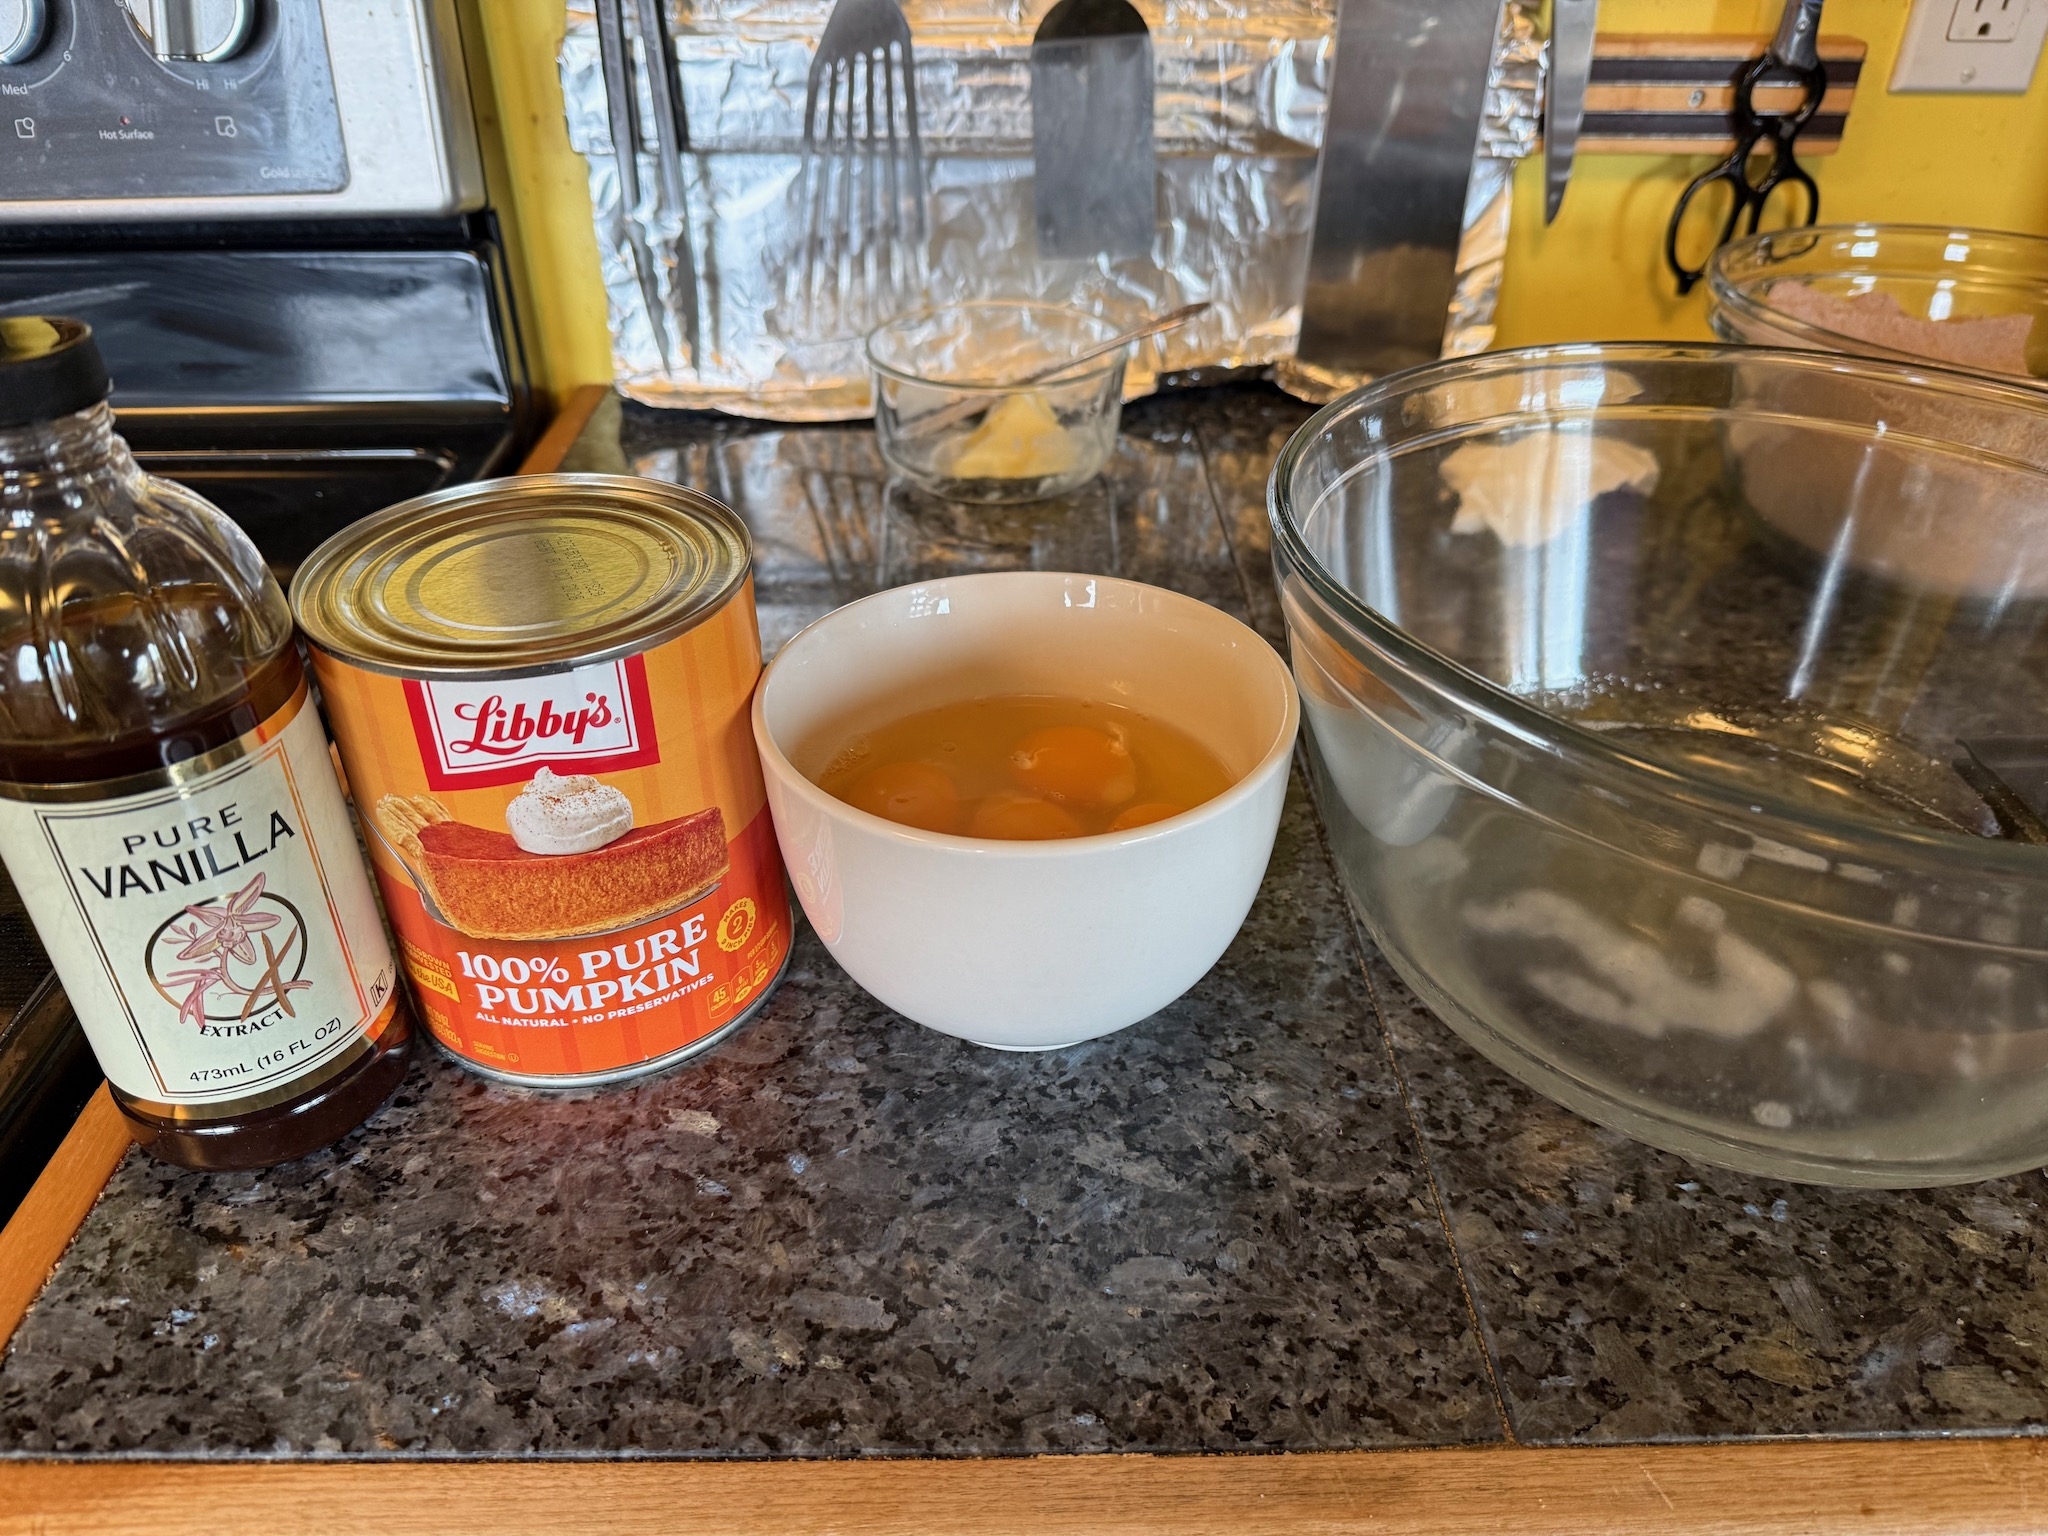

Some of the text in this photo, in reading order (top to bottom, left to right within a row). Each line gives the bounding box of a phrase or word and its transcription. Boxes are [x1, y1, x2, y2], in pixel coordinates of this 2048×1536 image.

[63, 51, 71, 62] 6
[2, 83, 28, 95] Med
[195, 79, 209, 91] Hi
[223, 79, 238, 91] Hi
[99, 129, 154, 140] Hot Surface
[450, 692, 612, 755] Libby's
[122, 802, 242, 855] PURE
[80, 810, 295, 898] VANILLA
[723, 900, 748, 923] MAKES
[732, 915, 743, 935] 2
[456, 913, 708, 984] 100% PURE
[431, 974, 454, 995] USA
[475, 948, 701, 1015] PUMPKIN
[475, 972, 715, 1028] ALL NATURAL NO PRESERVATIVES
[713, 987, 727, 1003] 45
[199, 1008, 284, 1037] EXTRACT
[189, 1017, 341, 1082] 473mL (16 FL OZ)
